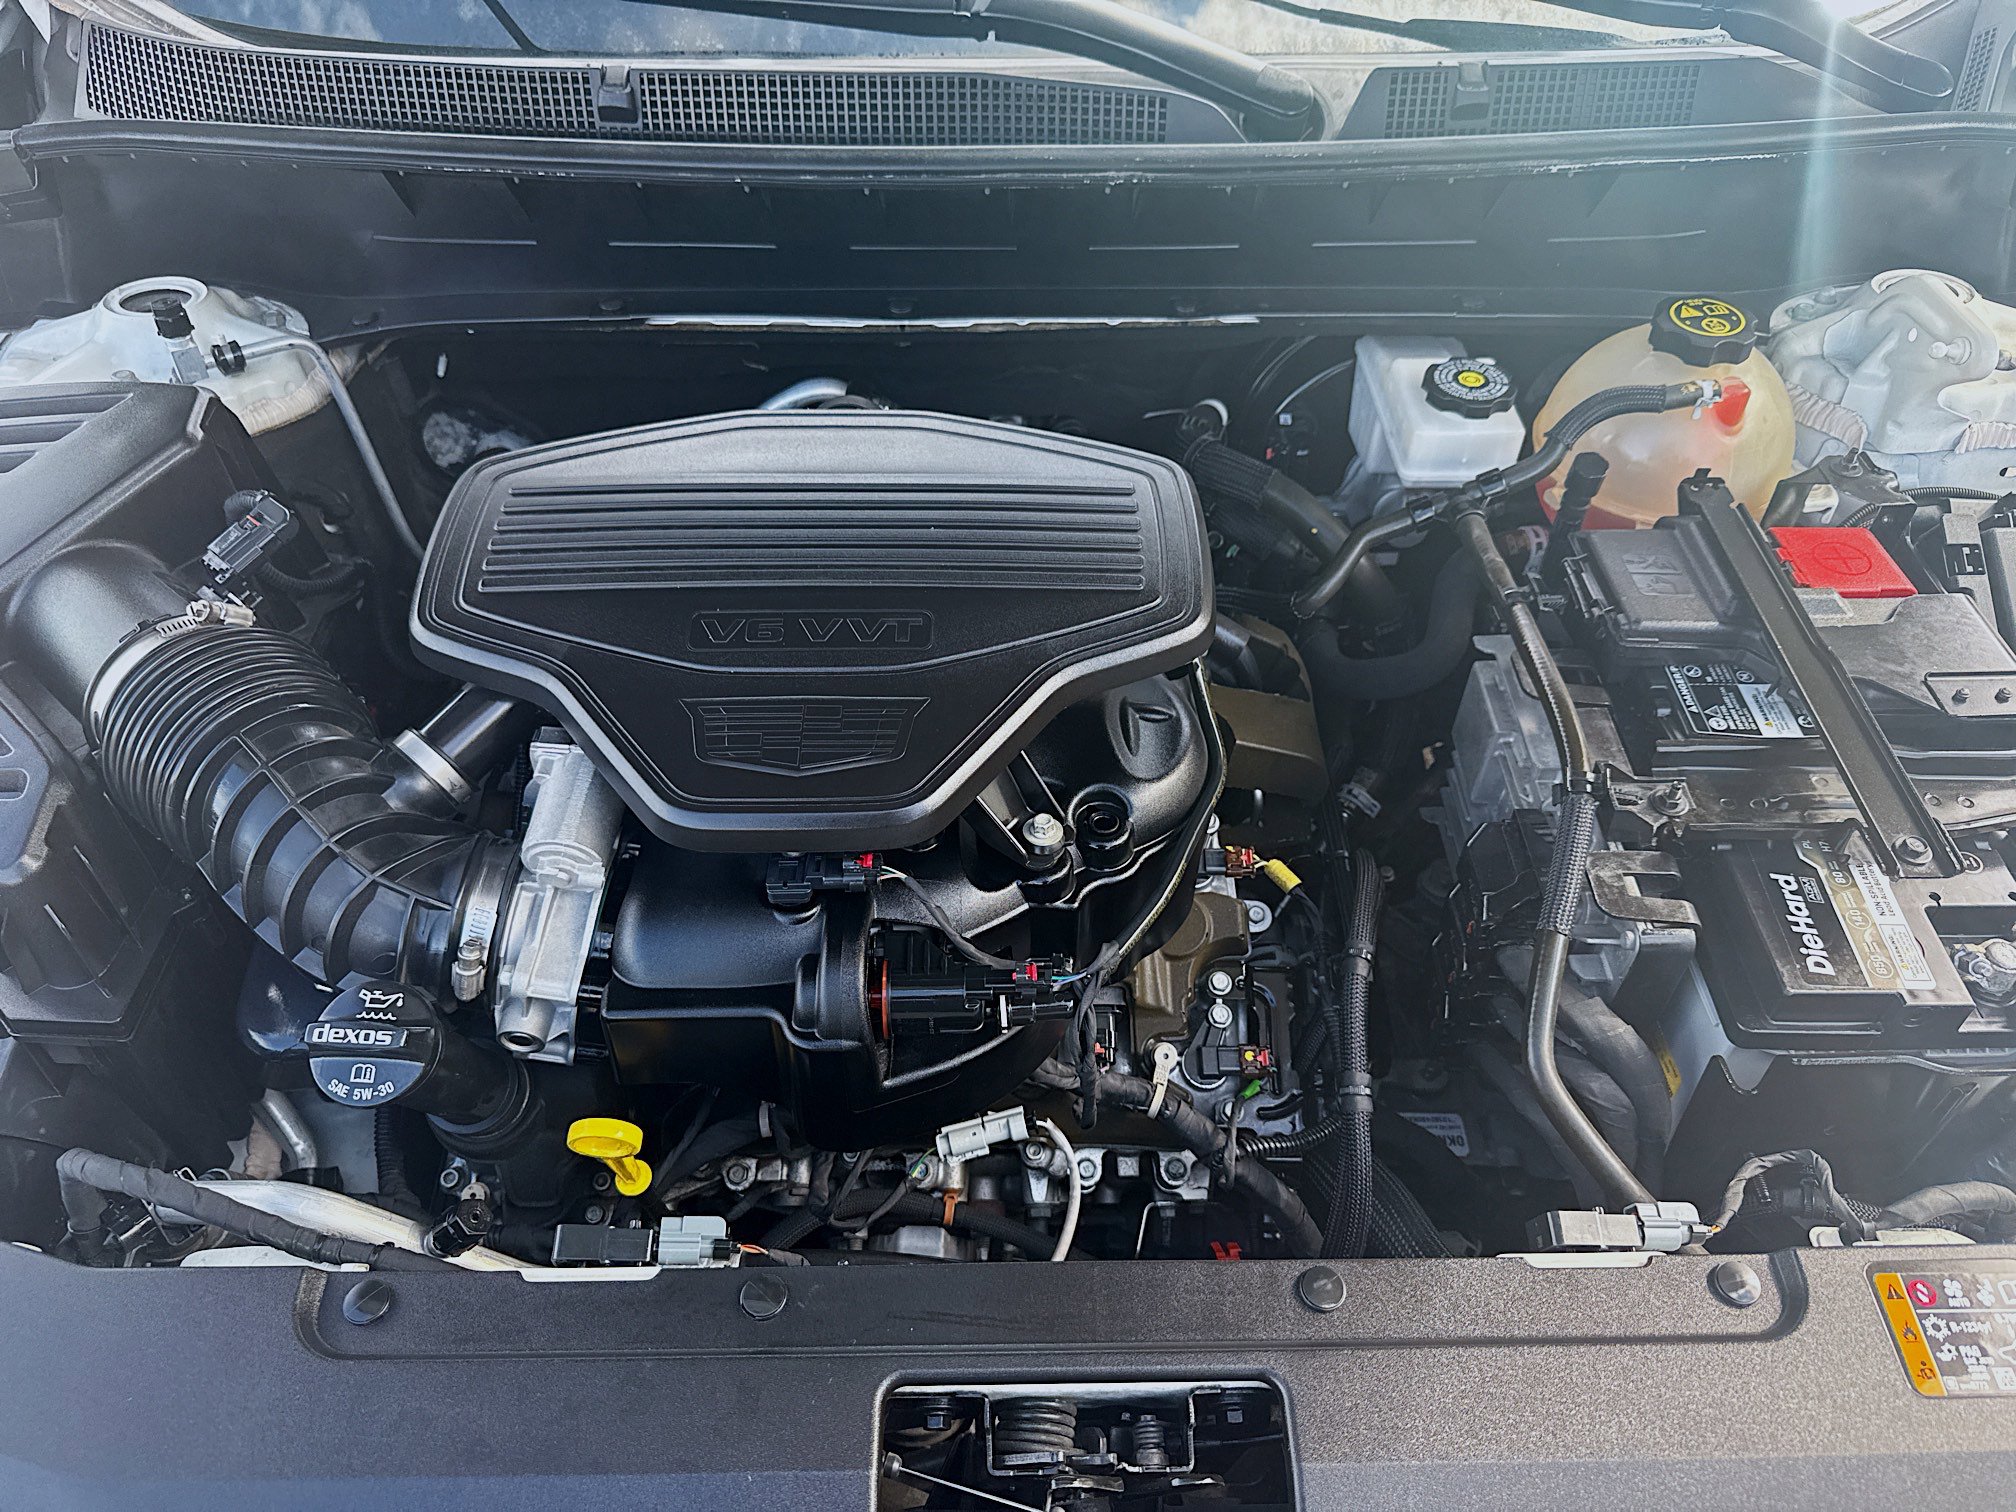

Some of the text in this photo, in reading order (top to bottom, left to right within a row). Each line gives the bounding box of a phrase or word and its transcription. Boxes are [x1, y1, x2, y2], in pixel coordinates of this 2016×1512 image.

[701, 618, 923, 643] V6 VVT
[1819, 841, 1832, 852] H7
[1832, 872, 1846, 884] 80
[1801, 879, 1817, 901] AGM
[1769, 873, 1836, 976] DieHard
[1870, 955, 1887, 975] 850
[312, 1024, 393, 1046] dexos
[328, 1079, 395, 1100] SAE 5W-30
